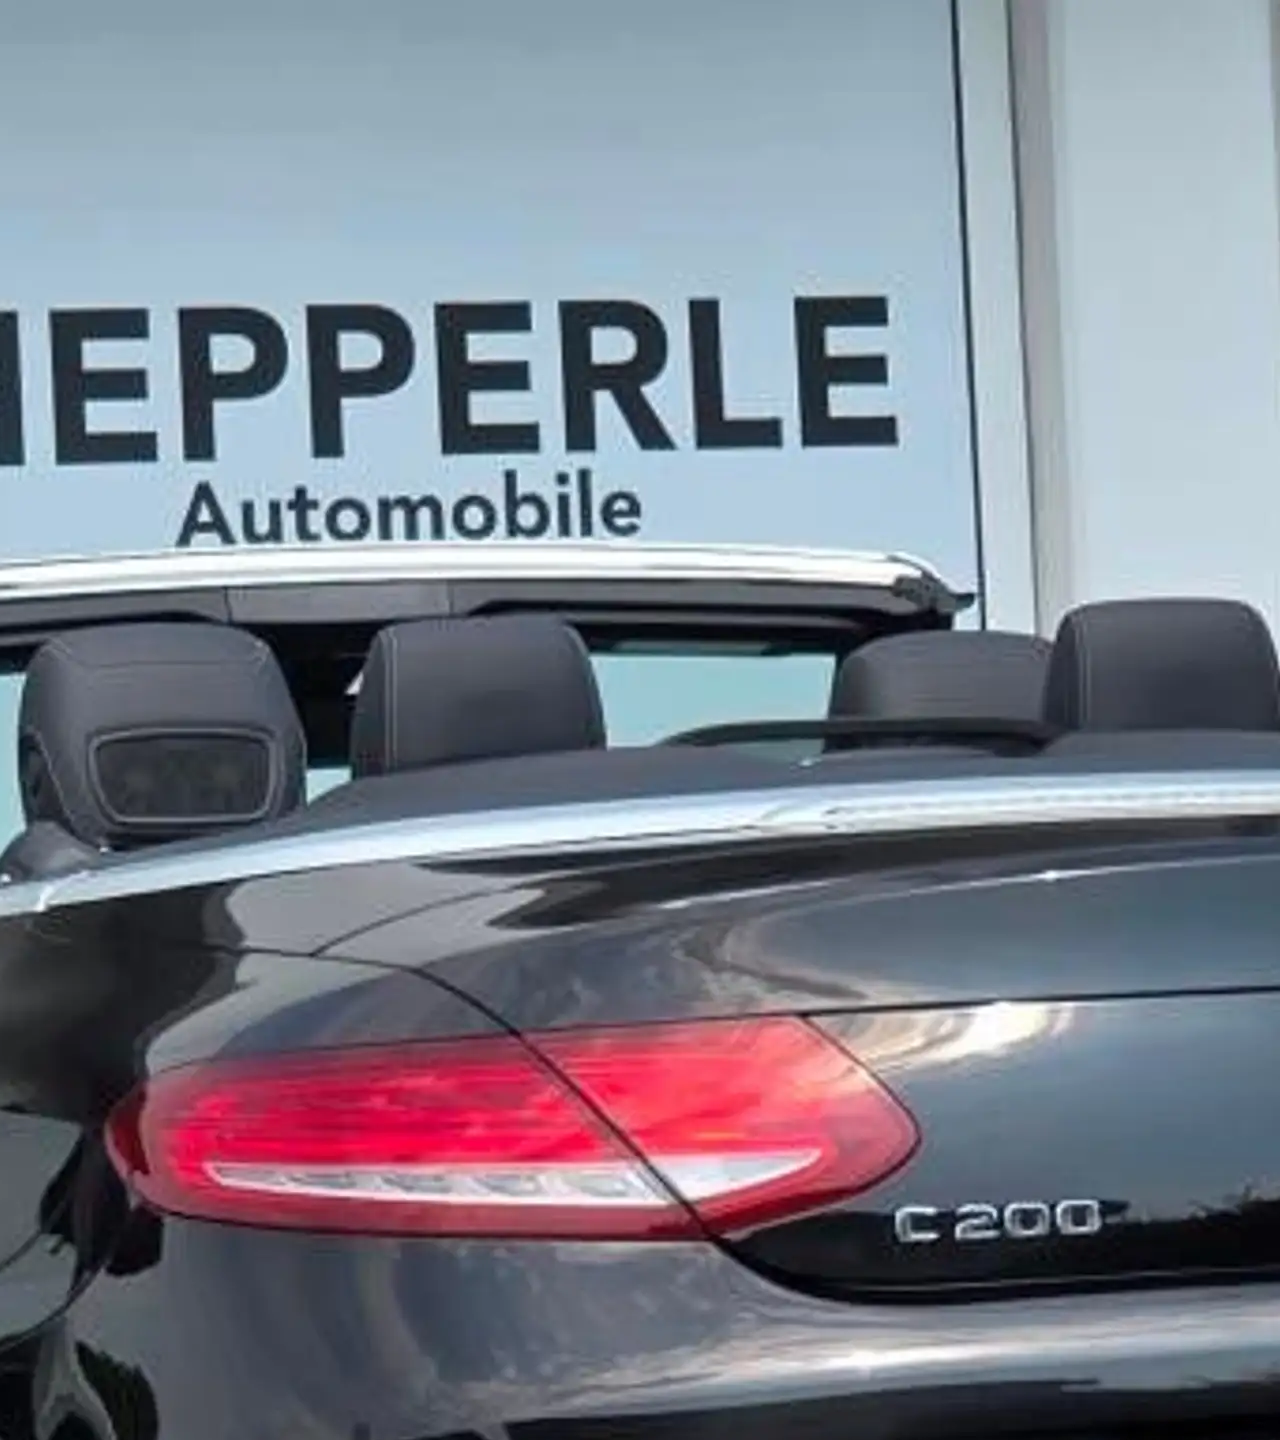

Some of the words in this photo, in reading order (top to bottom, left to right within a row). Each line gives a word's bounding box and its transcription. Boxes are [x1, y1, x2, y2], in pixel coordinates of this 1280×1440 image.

[175, 467, 642, 548] Automobile
[894, 1205, 940, 1243] C
[954, 1199, 1102, 1241] 200
